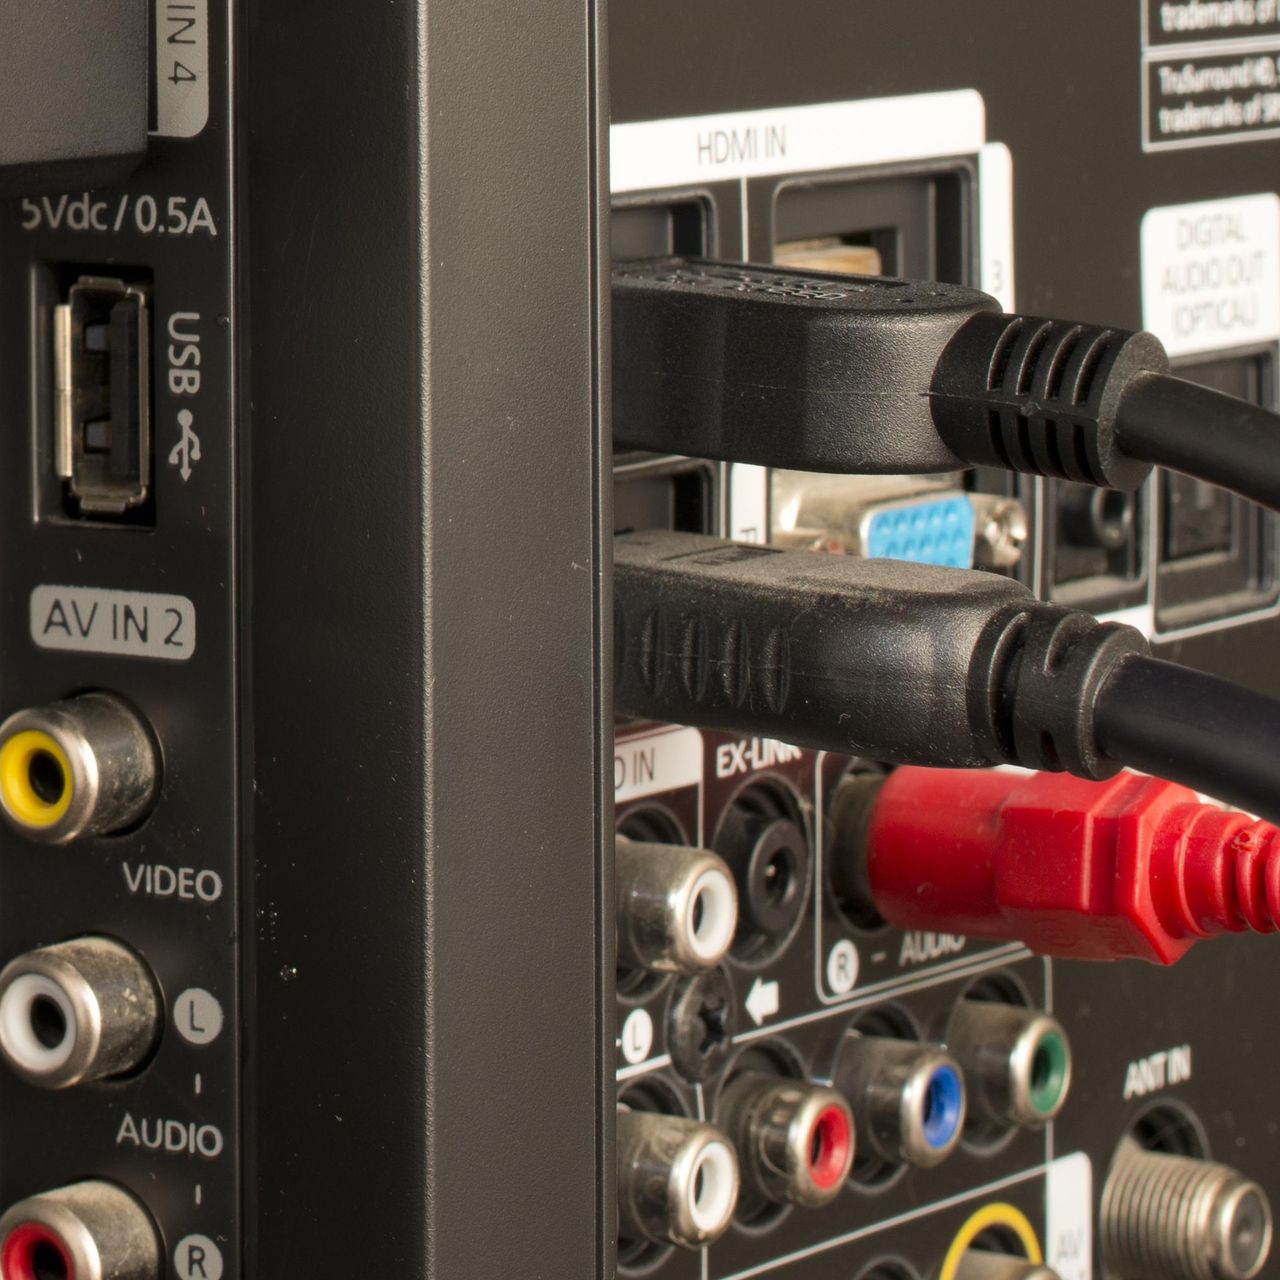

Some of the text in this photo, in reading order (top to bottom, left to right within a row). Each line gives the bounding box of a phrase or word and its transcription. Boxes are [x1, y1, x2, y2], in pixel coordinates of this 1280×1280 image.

[166, 4, 197, 45] IN
[168, 60, 198, 85] 4
[1158, 95, 1243, 133] trademarks
[1243, 91, 1263, 125] of
[697, 123, 788, 166] HDMI IN
[1176, 213, 1247, 251] DIGITAL
[1161, 249, 1266, 296] AUDIO OUT
[167, 311, 201, 395] USB
[43, 598, 185, 647] AV IN 2
[631, 746, 656, 787] IN
[122, 860, 223, 902] VIDEO
[1122, 1042, 1192, 1101] ANT IN
[116, 1112, 224, 1158] AUDIO
